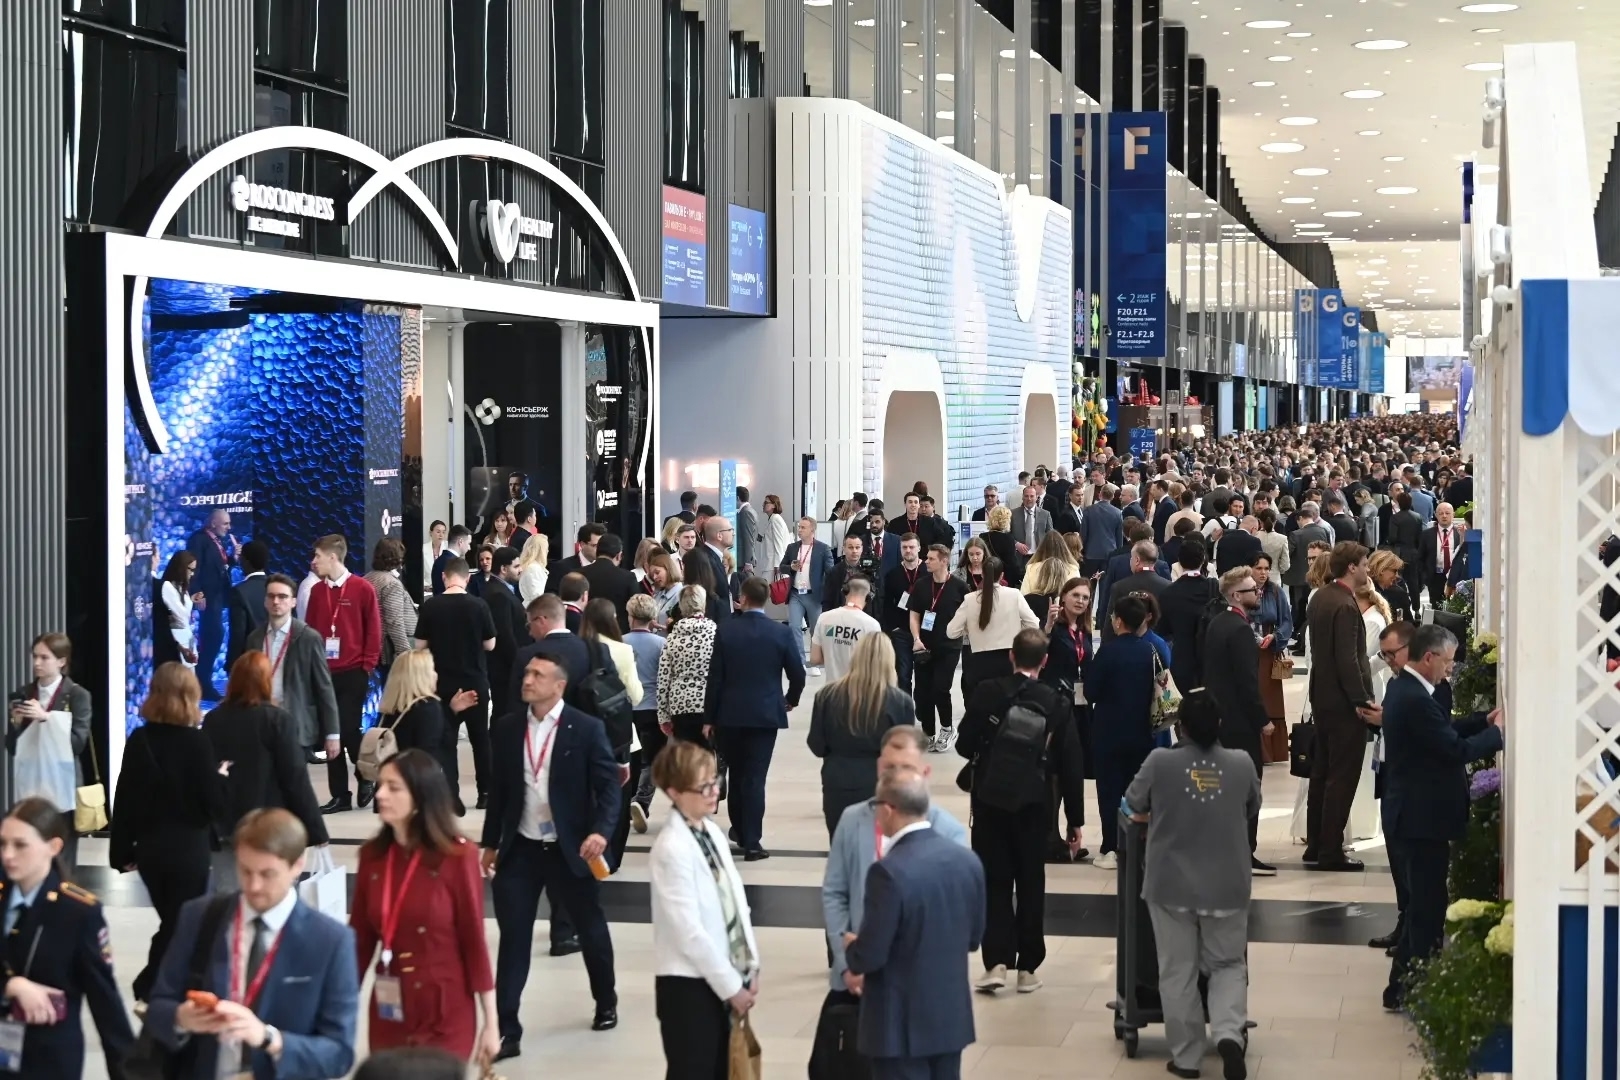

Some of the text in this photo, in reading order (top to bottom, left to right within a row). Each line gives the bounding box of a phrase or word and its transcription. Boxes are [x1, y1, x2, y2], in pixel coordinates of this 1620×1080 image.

[1124, 126, 1151, 171] F
[520, 216, 554, 239] HEALTHY
[519, 241, 537, 261] LIFE
[1130, 293, 1156, 303] 2 F
[1323, 295, 1338, 312] G
[1117, 308, 1133, 316] F20,
[1343, 312, 1356, 327] G
[1140, 428, 1146, 438] 2
[835, 625, 862, 641] РБК
